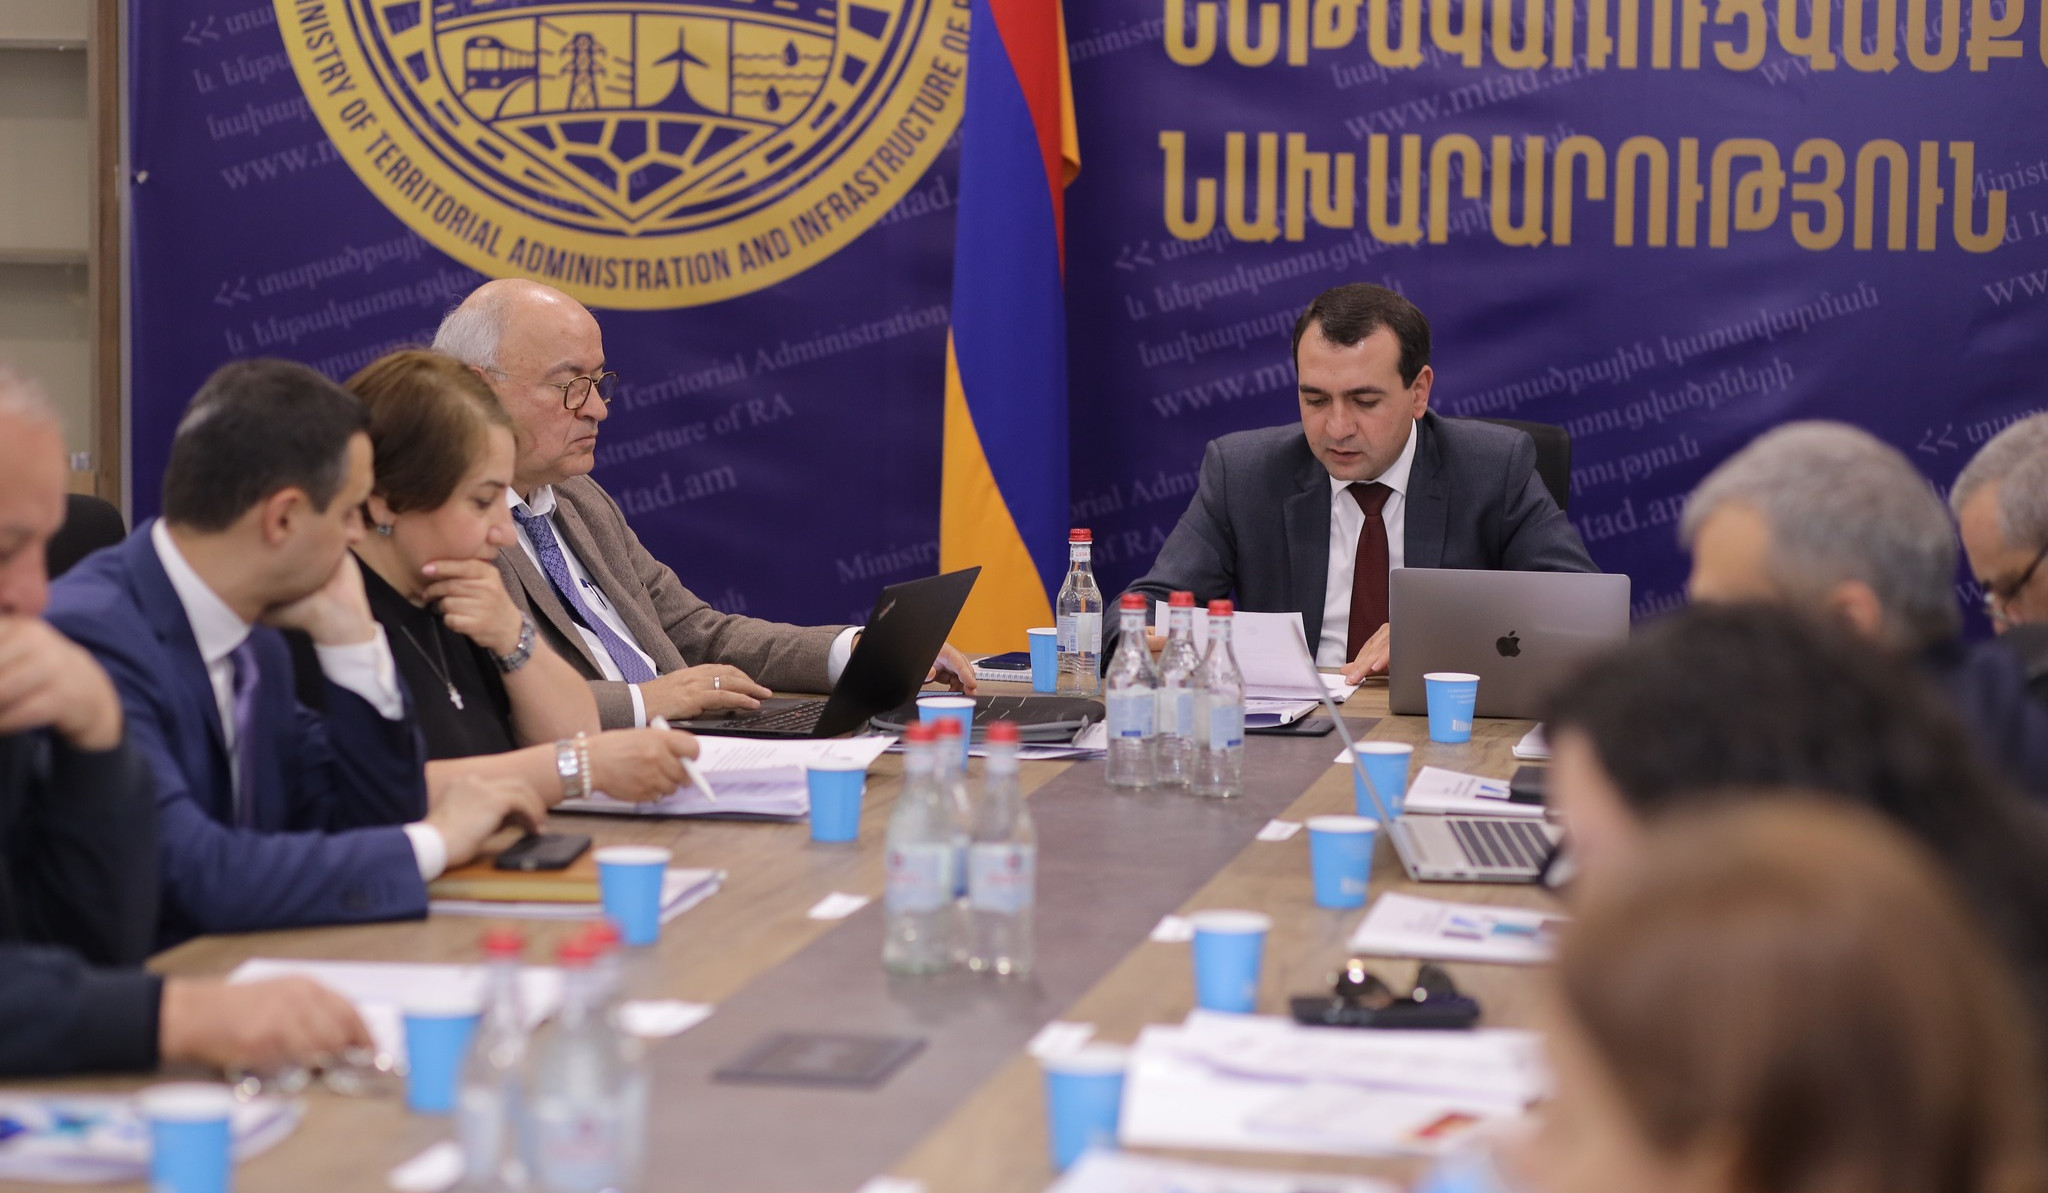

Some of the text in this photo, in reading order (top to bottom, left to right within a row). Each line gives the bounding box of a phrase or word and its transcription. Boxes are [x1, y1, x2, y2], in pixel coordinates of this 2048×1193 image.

[340, 98, 377, 132] OF
[364, 129, 504, 257] TERRITORIAL
[507, 236, 731, 291] ADMINISTRATION
[738, 227, 791, 274] AND
[790, 56, 962, 247] INFRASTRUCTURE
[1159, 131, 2007, 253] ՆԱԽԱՐԱՐՈՒԹՅՈՒՆ
[618, 304, 950, 411] Territorial Administration
[595, 391, 796, 467] structure of RA
